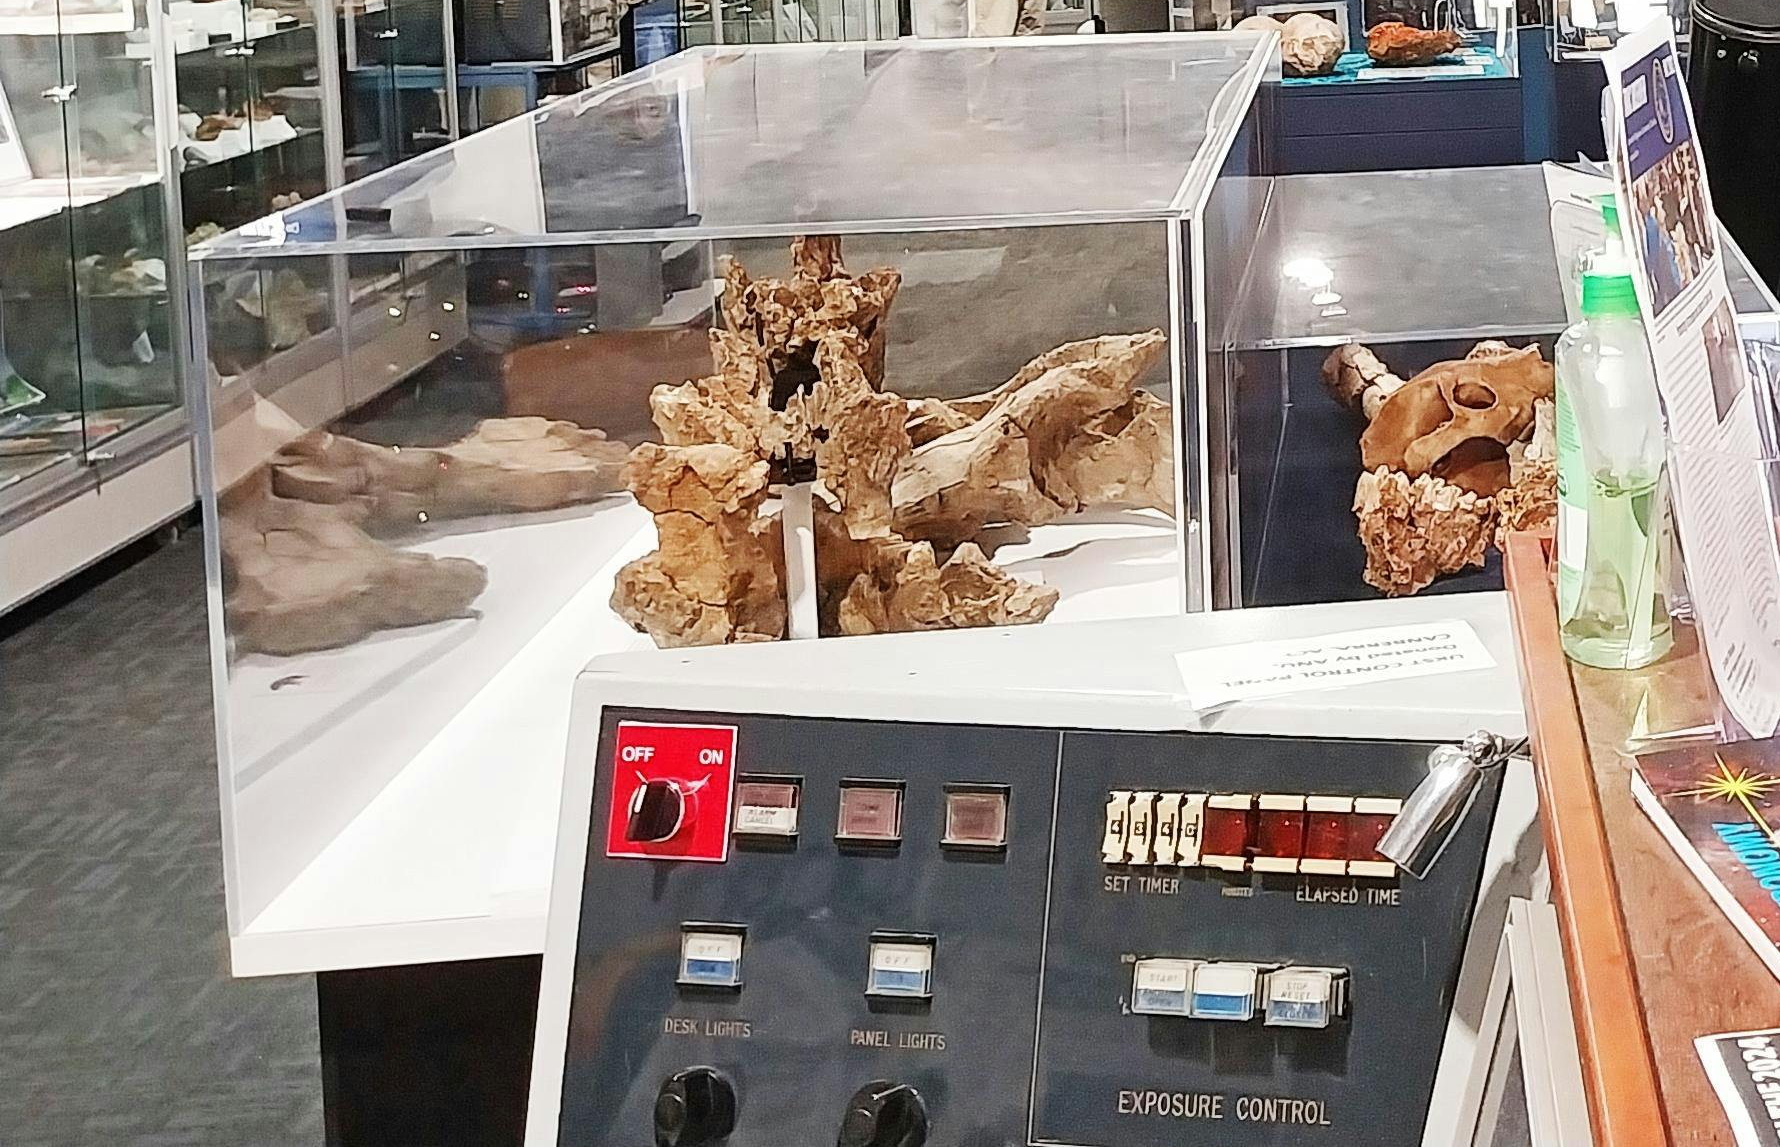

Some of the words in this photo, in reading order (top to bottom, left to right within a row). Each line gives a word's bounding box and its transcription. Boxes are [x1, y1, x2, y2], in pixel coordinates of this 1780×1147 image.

[1336, 653, 1360, 664] by
[1369, 642, 1457, 660] Donated
[1409, 653, 1465, 667] UKST
[1301, 661, 1403, 679] CONTROL
[622, 746, 655, 762] OFF
[699, 749, 723, 765] ON
[1104, 876, 1131, 891] SET
[1138, 877, 1179, 894] TIMER
[1296, 885, 1358, 904] ELAPSED
[1366, 889, 1401, 906] TIME
[664, 1018, 697, 1035] DESK
[705, 1020, 750, 1038] LIGHTS
[850, 1029, 890, 1047] PANEL
[899, 1033, 946, 1050] LIGHTS
[1118, 1090, 1224, 1120] EXPOSURE
[1236, 1096, 1331, 1126] CONTROL
